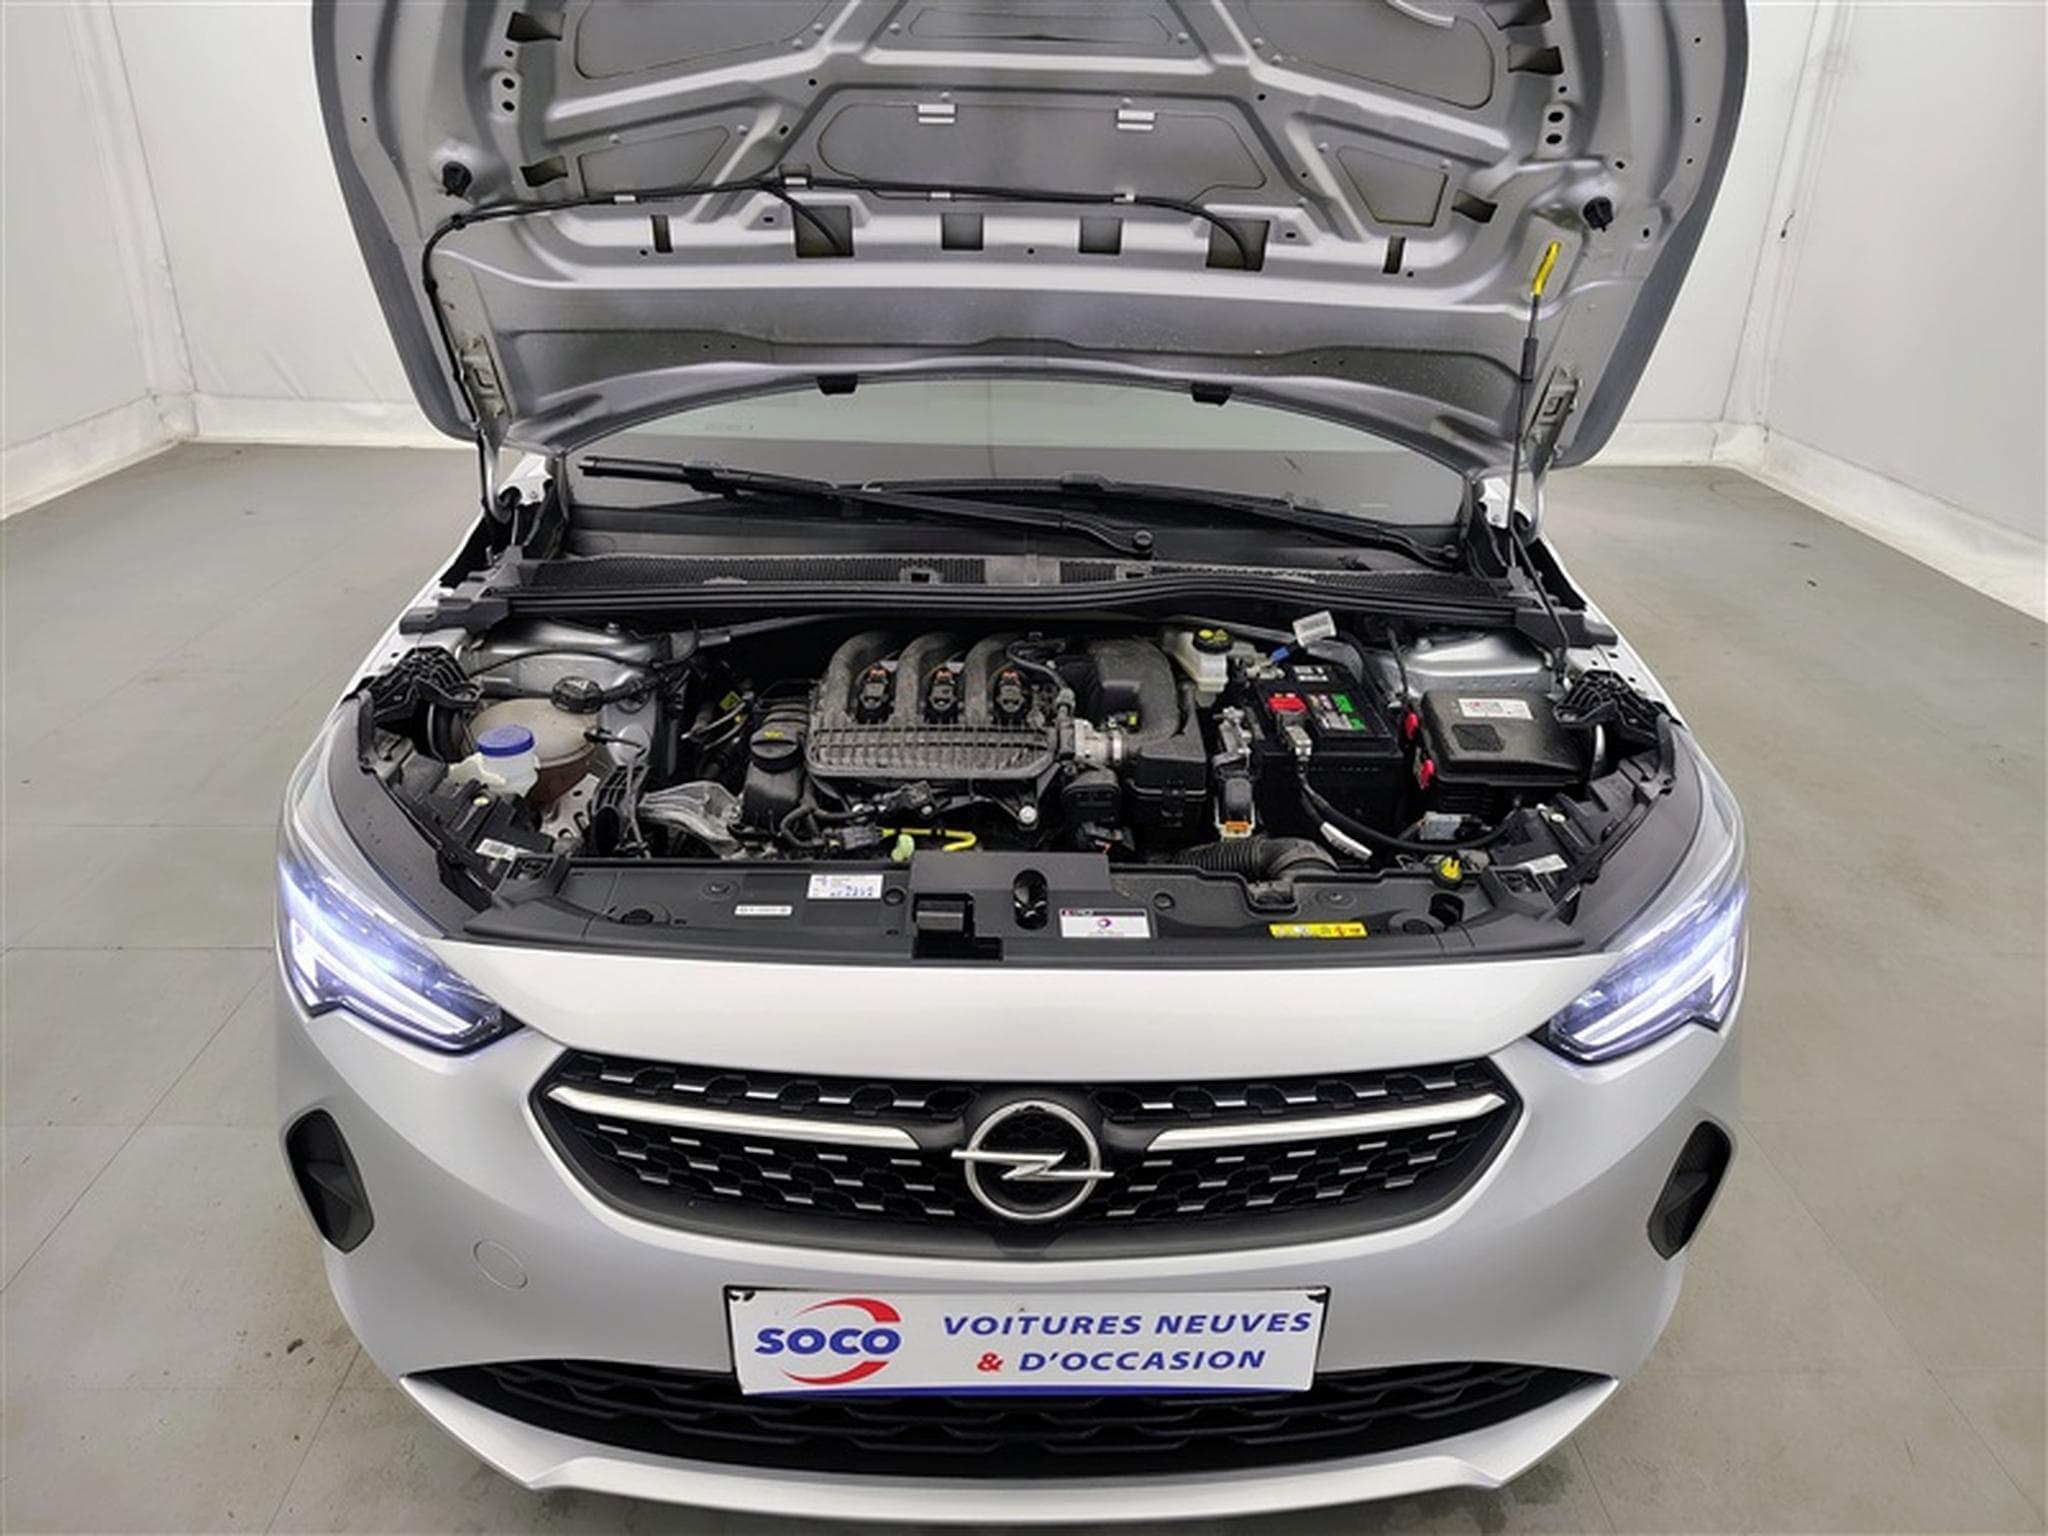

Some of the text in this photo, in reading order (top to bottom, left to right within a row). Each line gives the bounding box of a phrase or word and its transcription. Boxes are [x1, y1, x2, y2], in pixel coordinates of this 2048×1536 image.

[943, 1311, 1312, 1336] VOITURES NEUVES
[754, 1327, 902, 1356] SOCO
[976, 1349, 1267, 1373] & D'OCCASION
